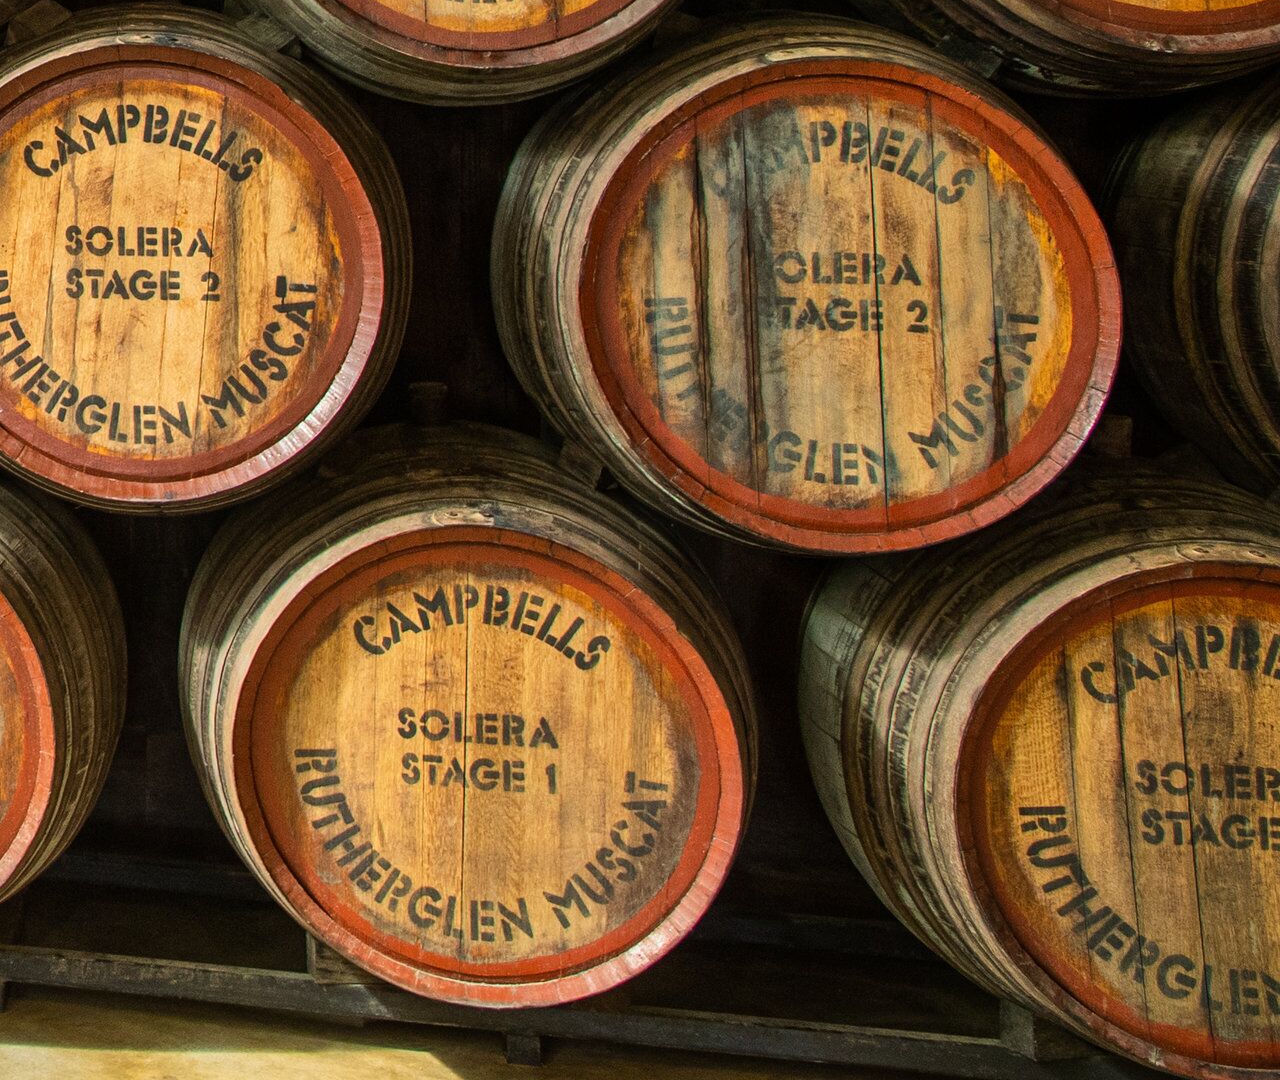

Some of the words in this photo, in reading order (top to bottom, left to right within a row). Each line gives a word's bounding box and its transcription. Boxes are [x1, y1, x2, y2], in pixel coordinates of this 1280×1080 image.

[23, 103, 264, 184] CAMPBELLS
[64, 225, 214, 258] SOLERA
[65, 269, 181, 301] STAGE
[200, 271, 220, 302] 2
[768, 251, 922, 286] OLERA
[762, 297, 883, 332] TAGE
[906, 298, 930, 334] 2
[201, 275, 318, 429] MUSCAT
[353, 583, 612, 672] CAMPBELLS
[397, 707, 559, 750] SOLERA
[401, 752, 525, 793] STAGE
[544, 763, 557, 795] 1
[294, 748, 535, 943] RUTHERGLEN
[543, 771, 669, 930] MUSCAT
[1141, 809, 1280, 851] STAGE
